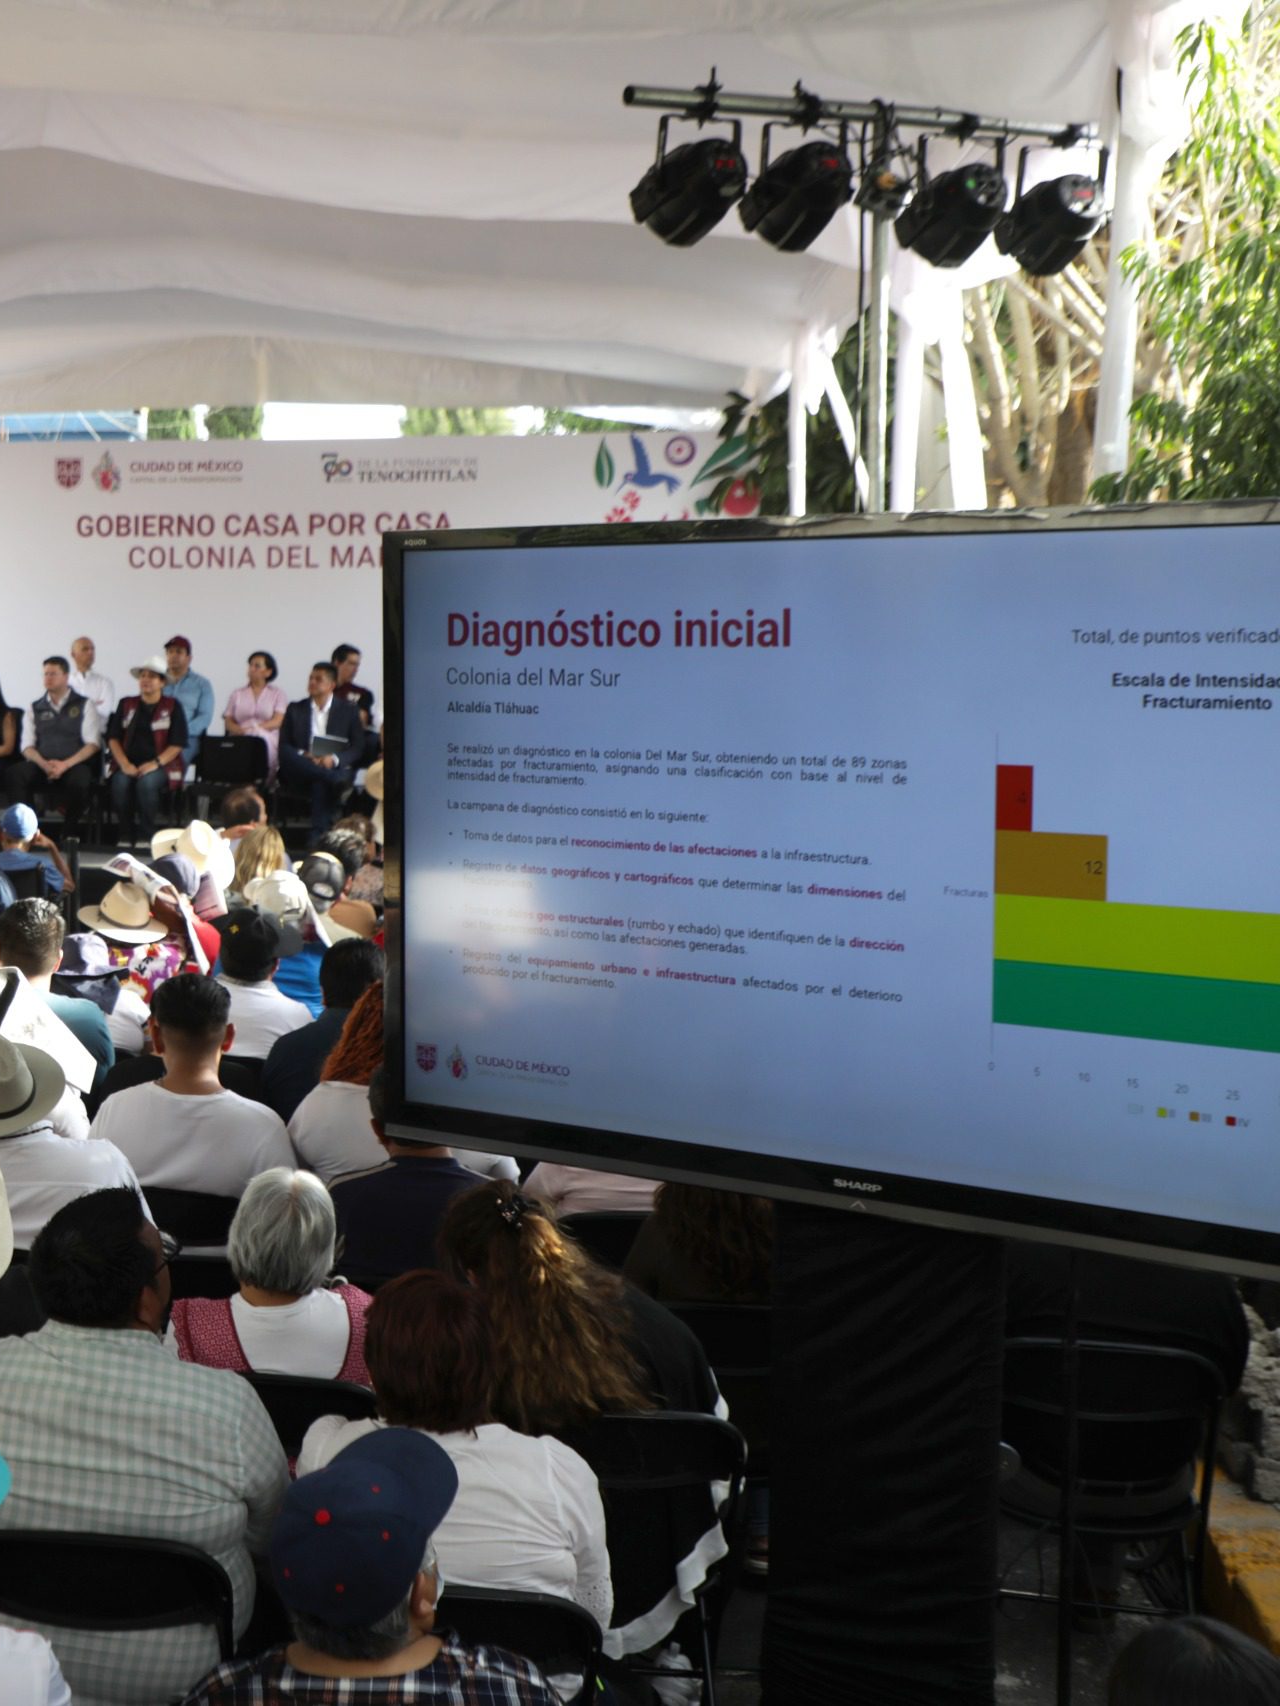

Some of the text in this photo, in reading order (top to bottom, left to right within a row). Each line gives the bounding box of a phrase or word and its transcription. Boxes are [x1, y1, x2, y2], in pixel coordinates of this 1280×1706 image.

[130, 459, 243, 473] CIUDAD DE MÉXICO
[358, 469, 478, 483] TENOCHTITLAN
[77, 513, 450, 538] GOBIERNO CASA POR CASA
[128, 544, 384, 569] COLONIA DEL MA
[447, 607, 792, 656] Diagnóstico inicial
[1072, 629, 1114, 645] Total,
[1119, 629, 1139, 643] de
[1143, 629, 1201, 646] puntos
[446, 667, 621, 687] Colonia del Mar Sur
[1112, 673, 1165, 687] Escala
[1169, 673, 1191, 687] de
[447, 701, 540, 715] Alcaldía Tláhuac
[1142, 694, 1272, 710] Fracturamiento
[447, 743, 907, 769] Se realizó un diagnóstico en la colonia Del Mar Sur, obteniendo un total de 89 zonas
[447, 757, 908, 785] afectadas por fracturamiento, asignando una clasificación con base al nivel de
[447, 771, 496, 782] intensidad
[498, 772, 510, 782] de
[447, 799, 459, 810] La
[507, 802, 519, 812] de
[522, 802, 579, 816] diagnóstico
[581, 807, 627, 818] consistió
[630, 810, 642, 819] en
[645, 809, 655, 820] lo
[464, 829, 872, 866] Toma de datos para el reconocimiento de las afectaciones a la infraestructura.
[1084, 860, 1104, 875] 12
[521, 863, 547, 875] datos
[551, 866, 610, 880] geográficos
[614, 872, 620, 881] y
[624, 872, 694, 886] cartográficos
[698, 878, 718, 889] que
[722, 877, 782, 892] determinar
[786, 882, 803, 894] las
[807, 883, 882, 900] dimensiones
[887, 889, 906, 902] del
[943, 886, 989, 898] Fracturas
[537, 912, 904, 952] geo estructurales (rumbo y echado) que identifiquen de la dirección
[571, 930, 599, 941] como
[602, 930, 616, 942] las
[619, 932, 686, 949] afectaciones
[463, 964, 510, 978] producido
[512, 969, 528, 980] por
[531, 969, 540, 980] el
[463, 948, 903, 1003] Registro del equipamiento urbano e infraestructura afectados por el deterioro
[475, 1055, 570, 1077] CIUDAD DE MÉXICO
[1034, 1067, 1041, 1077] 5
[1127, 1078, 1140, 1089] 15
[1175, 1083, 1189, 1095] 20
[1225, 1089, 1240, 1101] 25
[833, 1178, 882, 1192] SHARP
